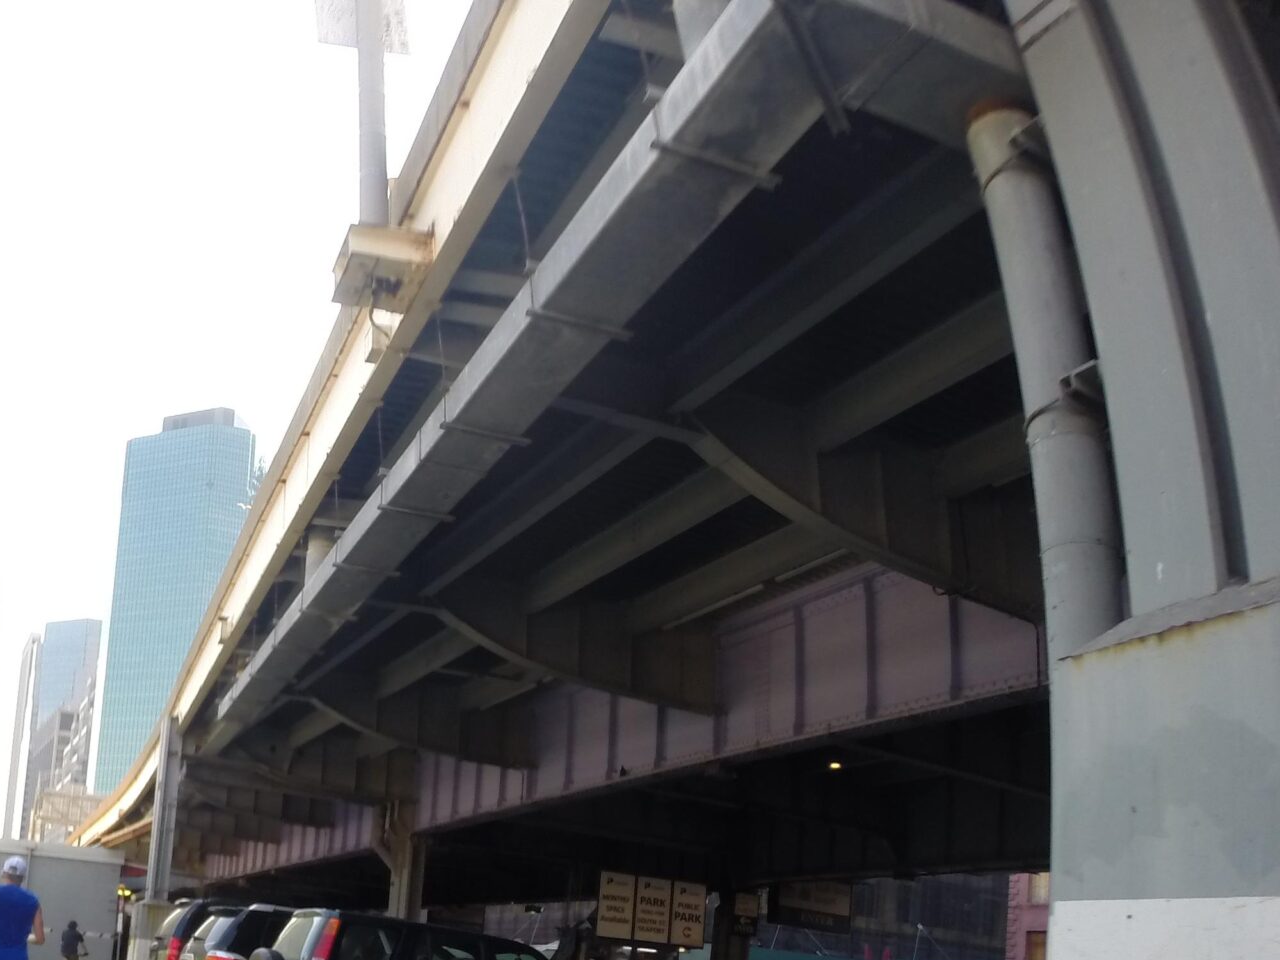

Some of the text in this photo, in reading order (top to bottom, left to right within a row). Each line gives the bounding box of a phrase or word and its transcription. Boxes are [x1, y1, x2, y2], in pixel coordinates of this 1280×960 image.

[640, 896, 666, 908] PARK
[677, 902, 700, 911] PUBLIC
[674, 911, 702, 924] PARK
